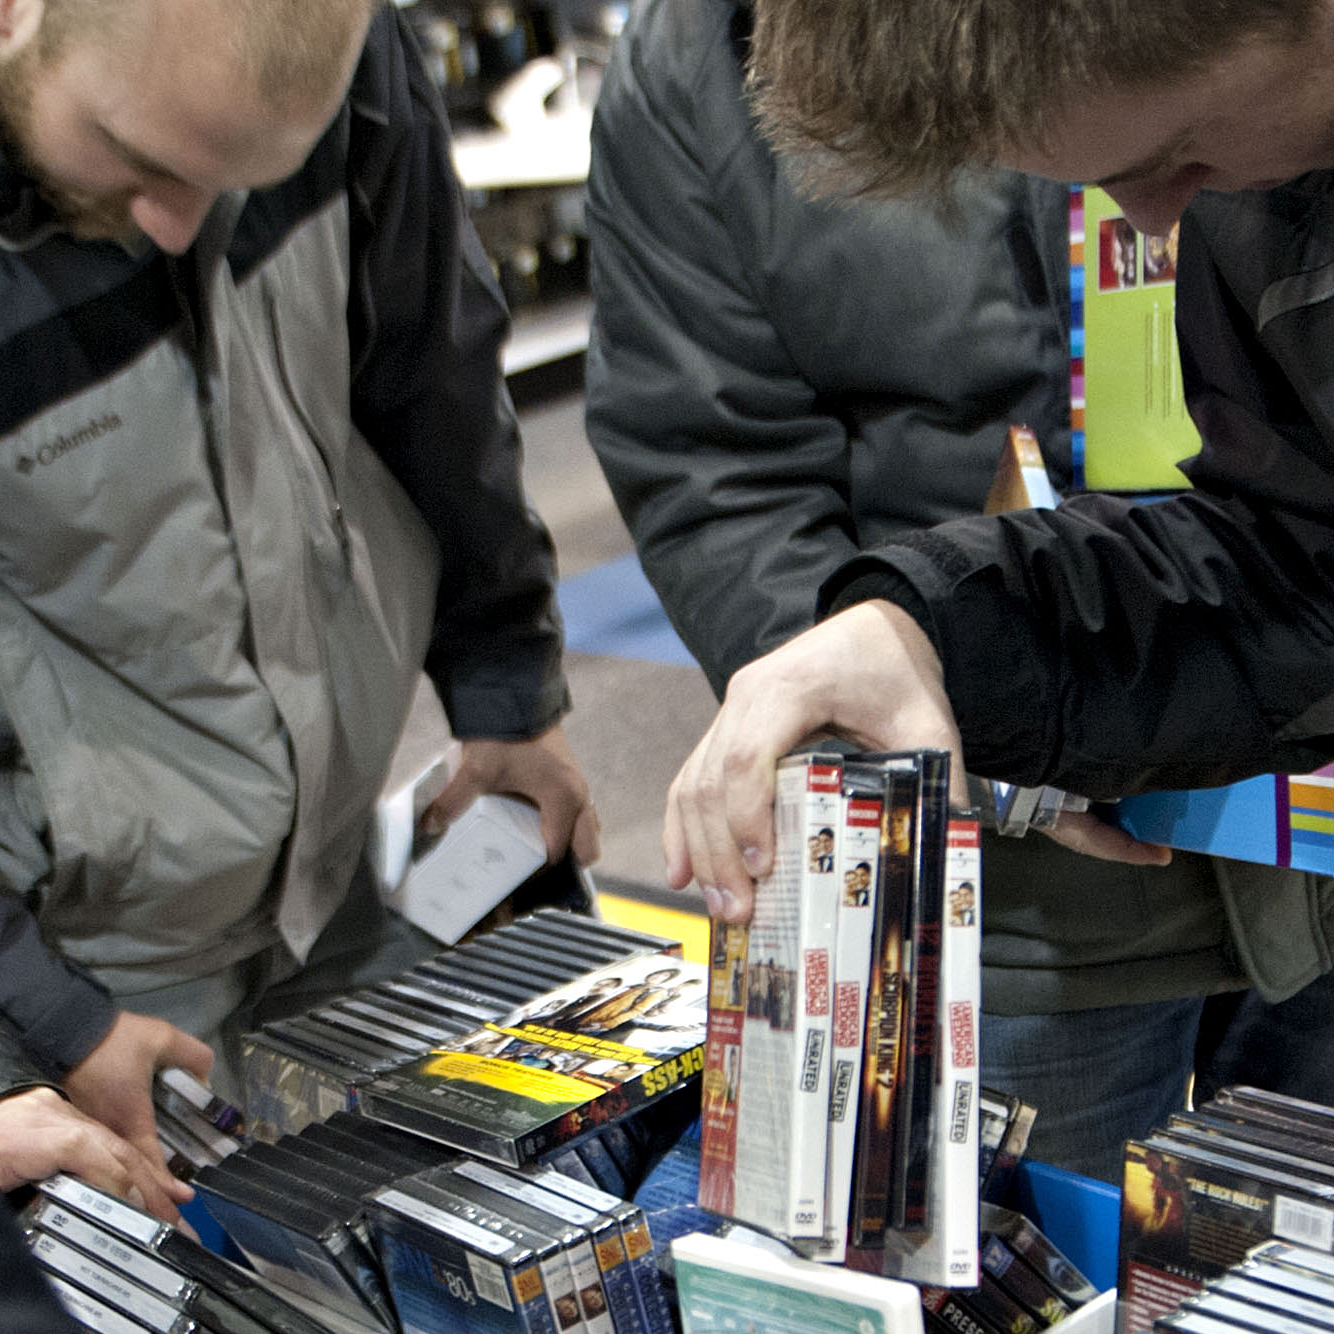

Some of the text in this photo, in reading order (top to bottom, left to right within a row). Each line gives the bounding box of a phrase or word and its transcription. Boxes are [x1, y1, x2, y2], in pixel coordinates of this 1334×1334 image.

[36, 411, 123, 467] Columbia
[838, 986, 849, 1046] WEDDING
[848, 986, 858, 1046] AMERICAN
[879, 972, 898, 1040] SCORPION
[962, 1005, 974, 1065] AMERICAN
[806, 1032, 822, 1090] UNRATED
[877, 1042, 893, 1073] KING
[952, 1006, 965, 1066] WEDDING
[639, 1042, 704, 1097] CK-ASS
[833, 1064, 850, 1118] UNRATED
[954, 1083, 968, 1140] UNRATED
